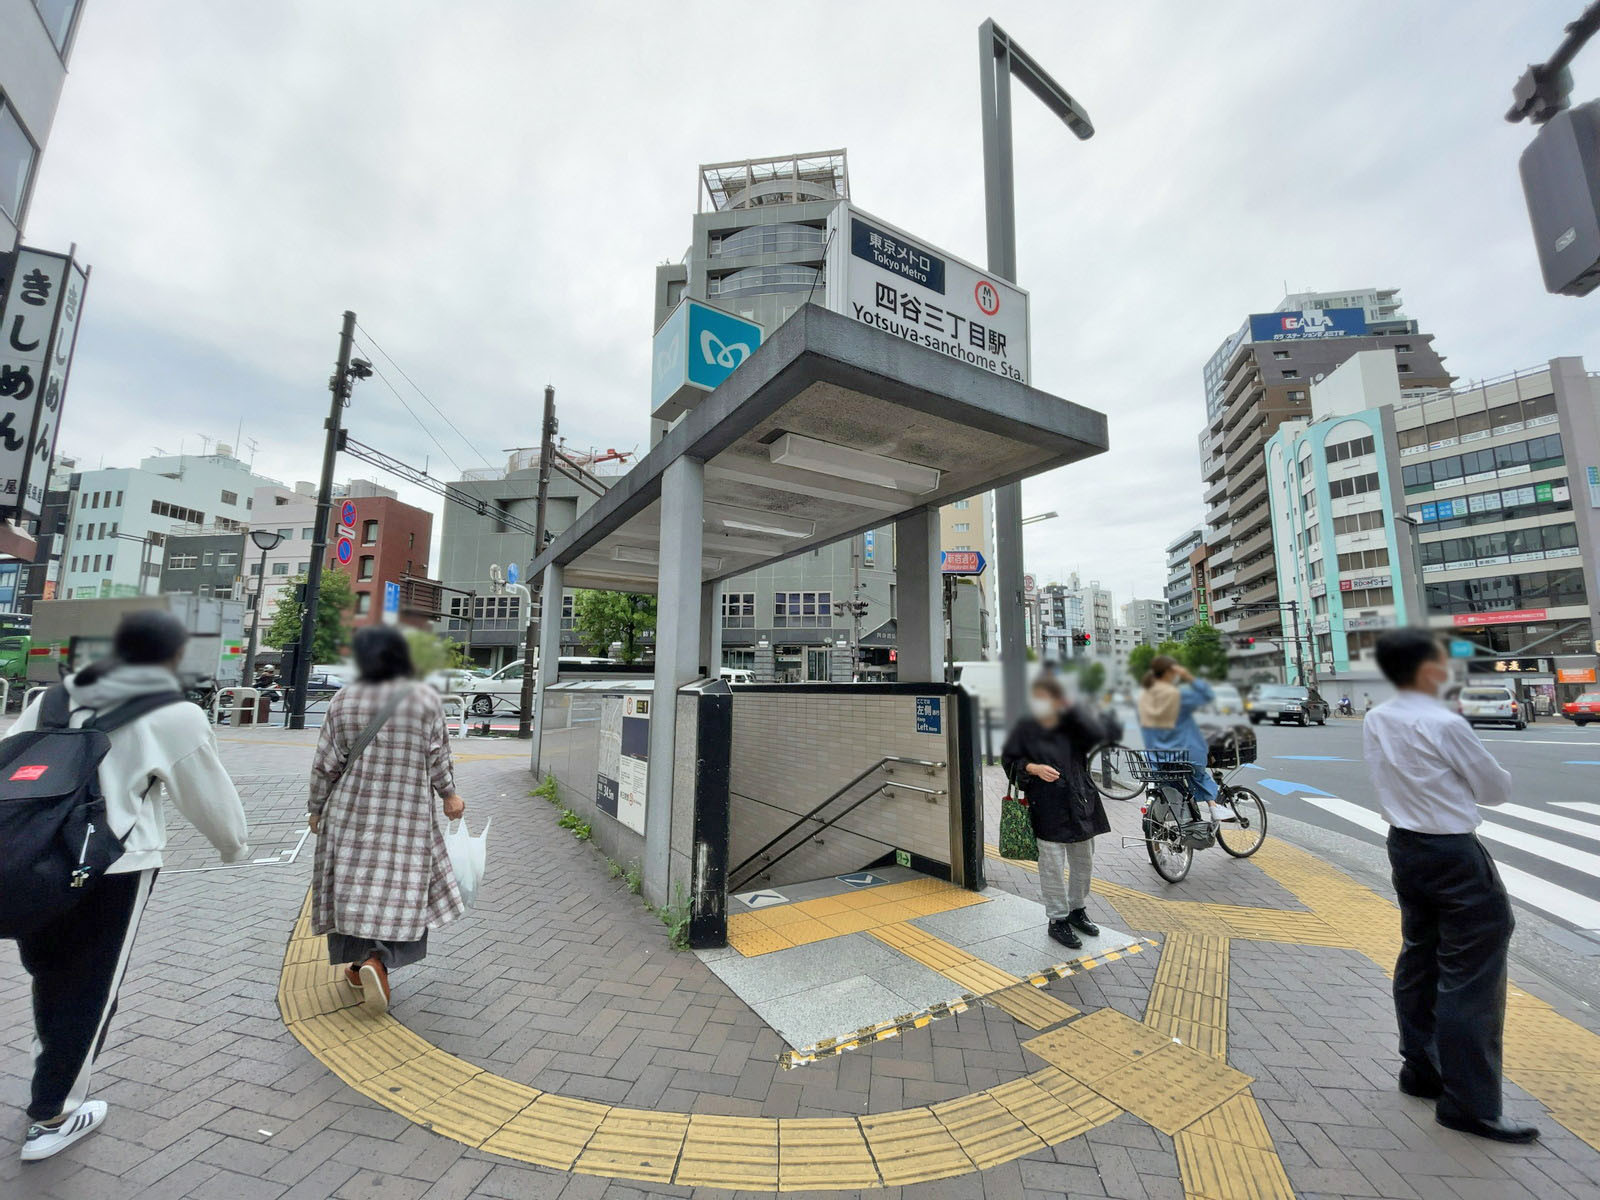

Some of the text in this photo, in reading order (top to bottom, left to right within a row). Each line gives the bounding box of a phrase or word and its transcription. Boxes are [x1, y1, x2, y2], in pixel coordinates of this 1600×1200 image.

[869, 232, 930, 272] 東京メトロ
[873, 250, 927, 283] Tokyo Metro
[982, 296, 992, 309] 11
[983, 286, 992, 296] M
[876, 281, 1007, 358] 四谷三丁目駅
[1283, 315, 1334, 330] GALA
[0, 268, 52, 451] きしめん
[852, 301, 1025, 382] Yotsuya-sanchome Sta.
[34, 284, 77, 462] きしめん
[917, 723, 929, 731] Left
